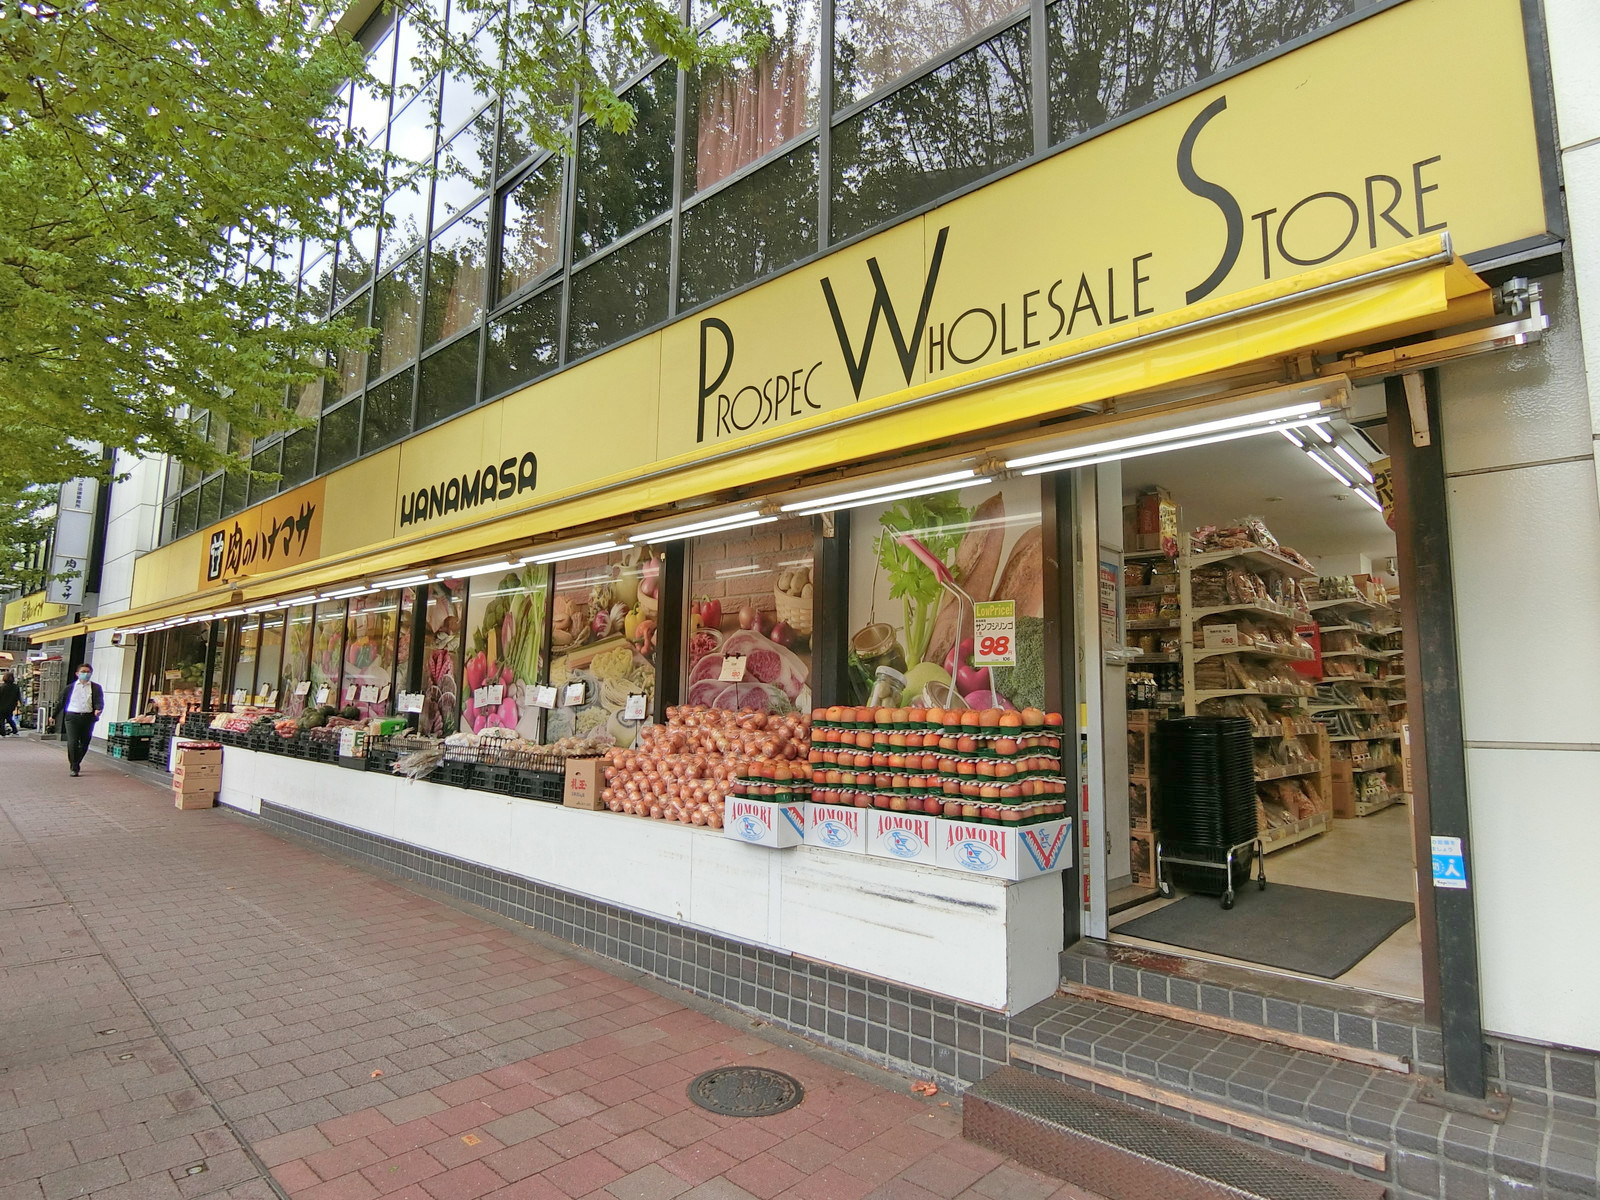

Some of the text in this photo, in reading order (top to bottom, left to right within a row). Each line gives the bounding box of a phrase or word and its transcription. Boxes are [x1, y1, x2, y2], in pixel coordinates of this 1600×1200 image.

[820, 225, 1155, 402] WHOLESALE
[1176, 94, 1448, 306] STORE
[400, 451, 538, 528] HANAMASA
[222, 500, 317, 579] 肉のハナマサ
[61, 558, 77, 601] 肉のナマサ
[976, 622, 1012, 631] サンフジリンゴ
[730, 801, 772, 831] AOMORI
[811, 806, 859, 837] AOMORI
[876, 814, 930, 848] AOMORI
[945, 824, 1007, 860] AOMORI
